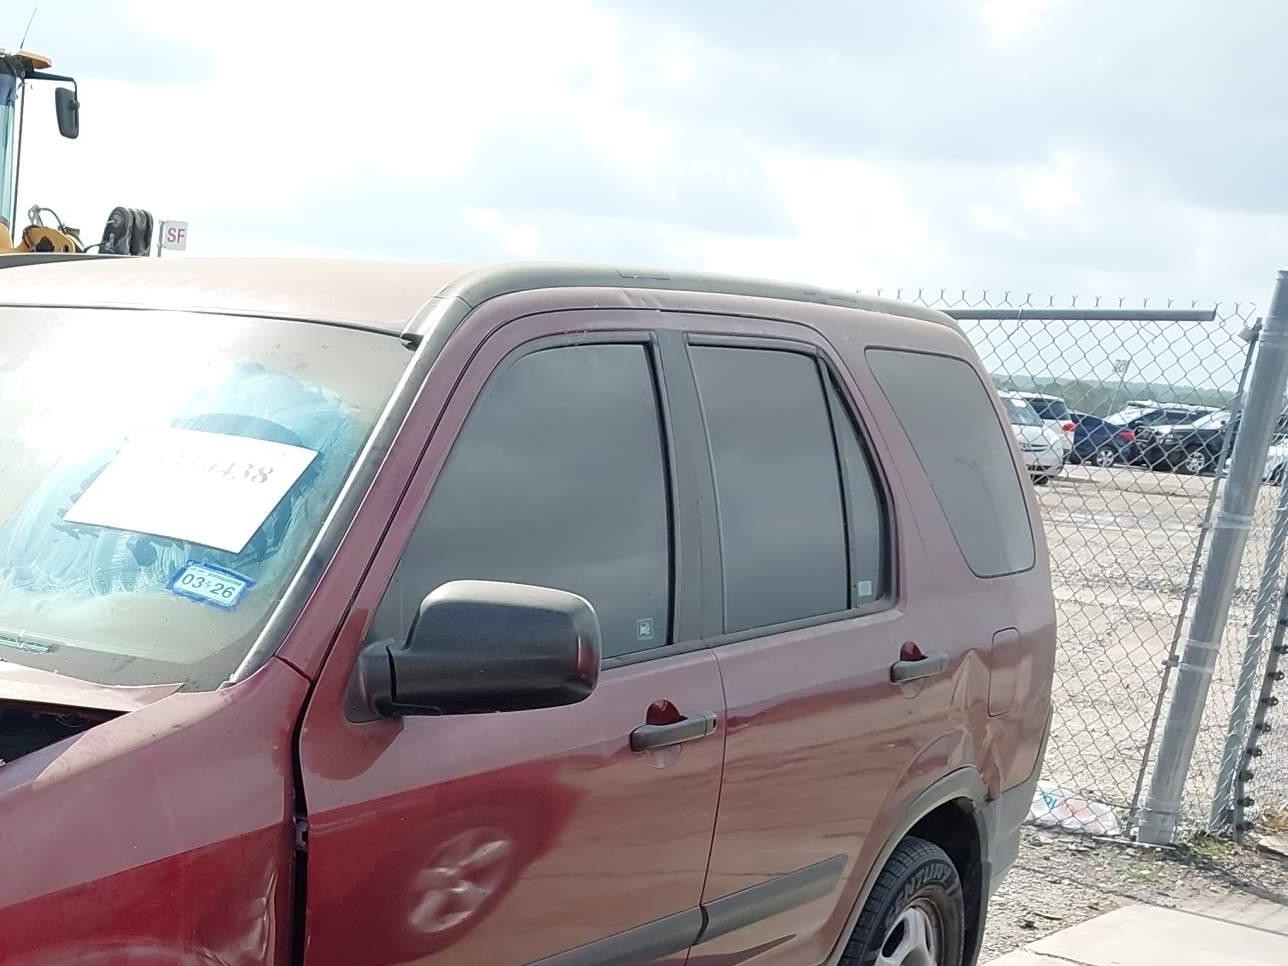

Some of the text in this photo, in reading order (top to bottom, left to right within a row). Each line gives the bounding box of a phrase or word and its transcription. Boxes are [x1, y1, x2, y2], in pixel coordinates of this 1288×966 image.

[167, 227, 186, 244] SF
[181, 573, 206, 589] 03
[209, 582, 236, 599] 26
